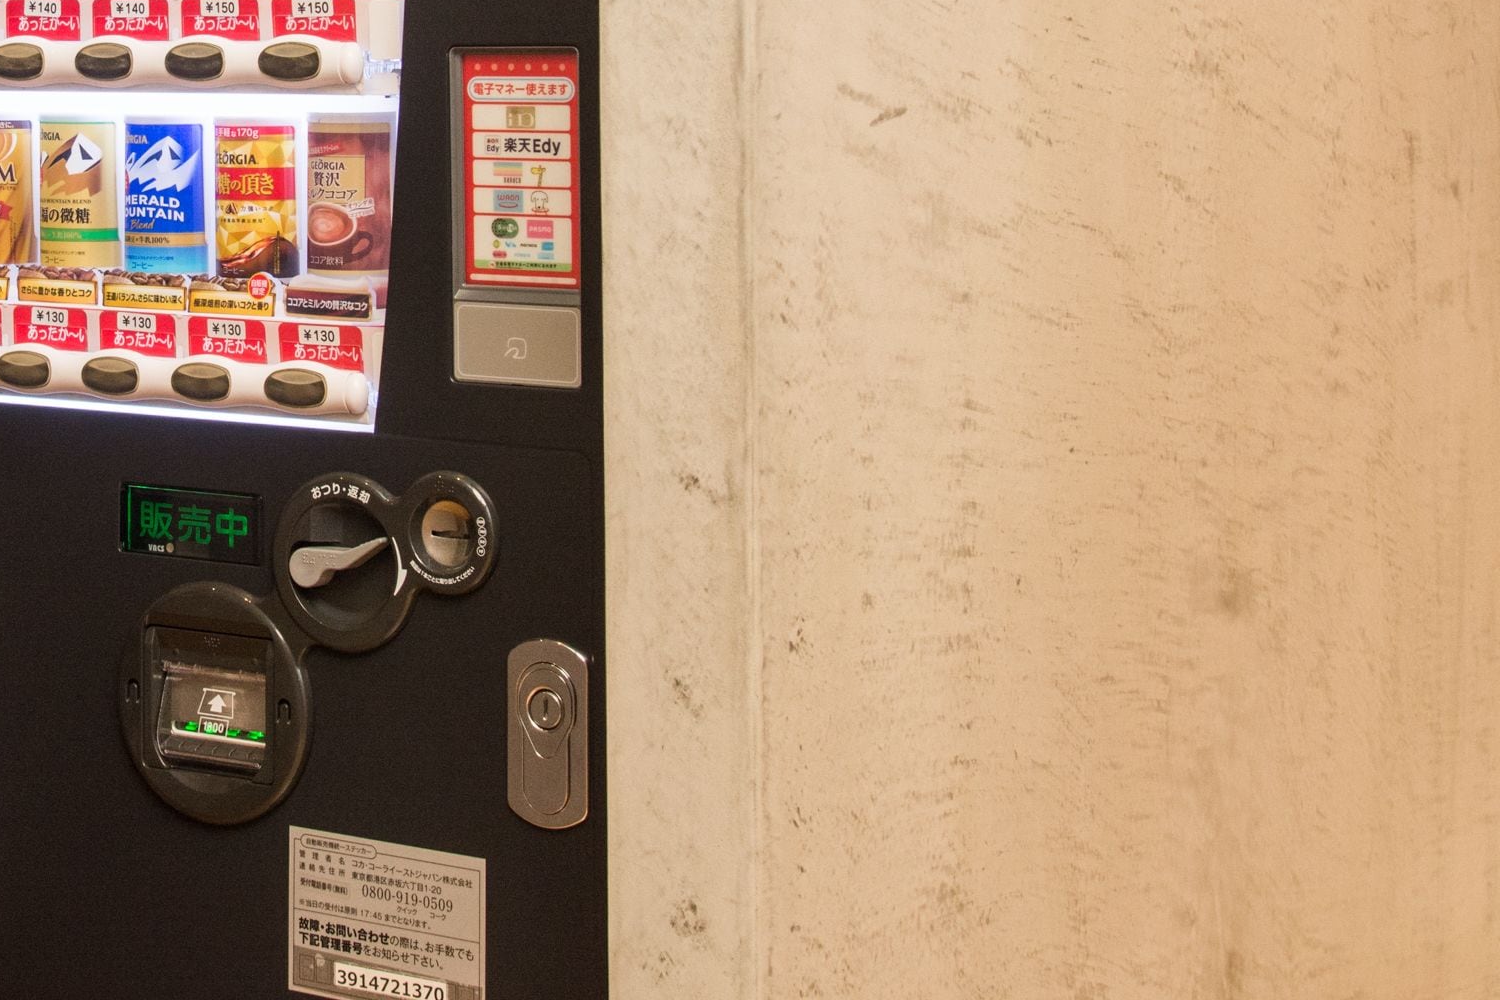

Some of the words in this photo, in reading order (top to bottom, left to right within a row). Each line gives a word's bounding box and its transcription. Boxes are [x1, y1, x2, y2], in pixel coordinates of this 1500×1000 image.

[28, 1, 57, 14] ¥140
[116, 2, 145, 14] ¥140
[205, 2, 235, 14] ¥150
[298, 2, 329, 14] ¥150
[473, 83, 568, 95] 電子マネー使えます
[504, 137, 561, 155] 楽天Edy
[218, 172, 275, 196] 糖の頂き
[314, 171, 340, 187] 贅沢
[21, 286, 93, 298] さらに豊かな香りとコク
[36, 310, 65, 323] ¥130
[122, 316, 152, 329] ¥130
[212, 323, 242, 336] ¥130
[303, 329, 335, 342] ¥130
[310, 482, 371, 504] おつり・返却
[140, 501, 248, 548] 販売中
[361, 884, 453, 912] 0800-919-0509
[298, 916, 475, 962] 故障・お問い合わせの際は、お手数でも
[299, 931, 443, 970] 下記管理番号をお知らせ下さい。
[336, 968, 445, 1000] 3914721370
